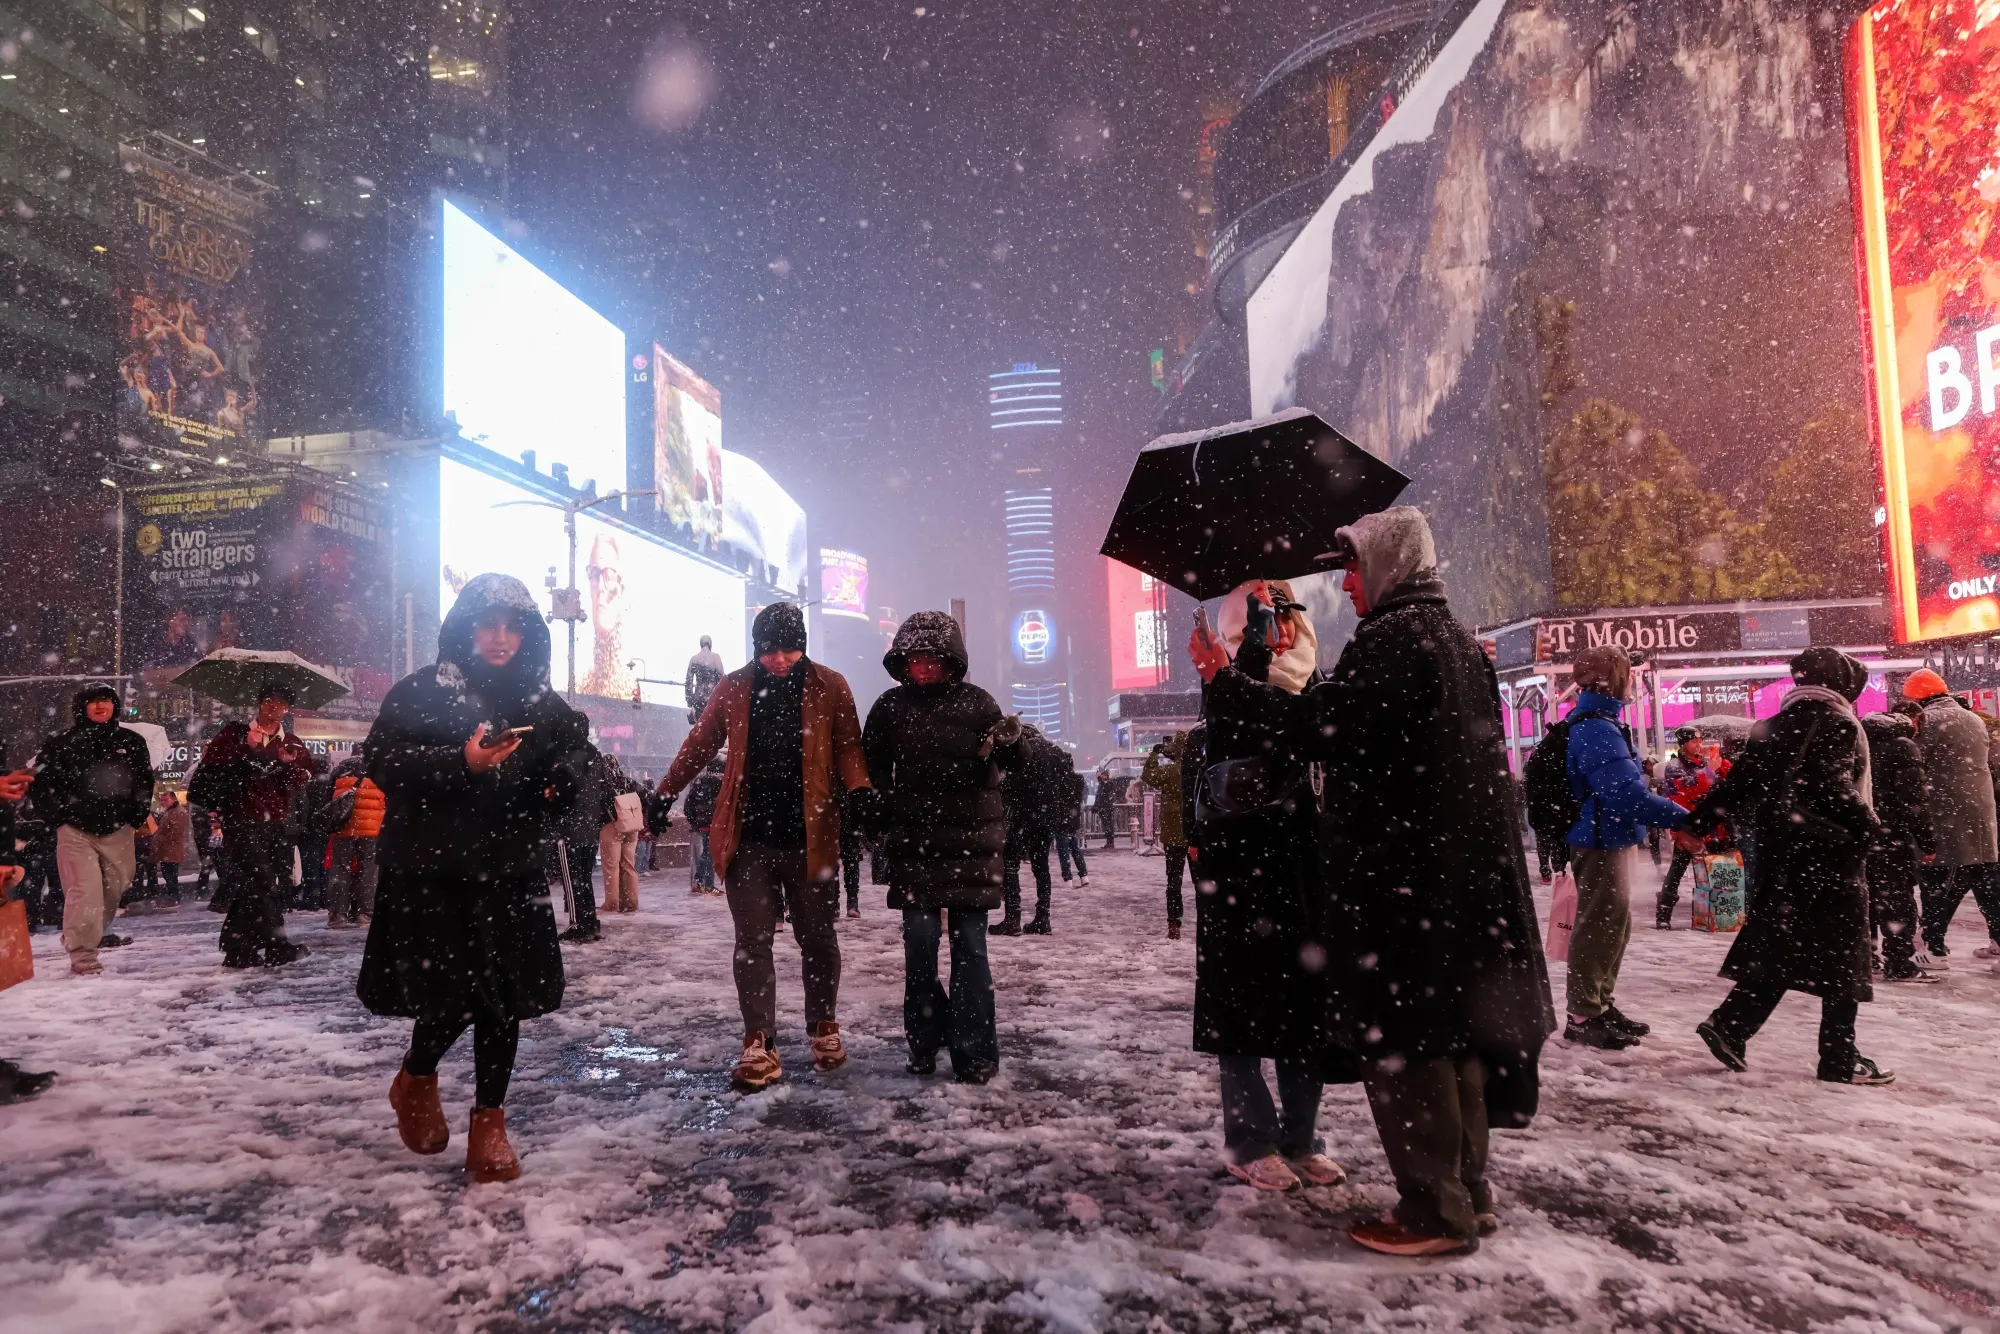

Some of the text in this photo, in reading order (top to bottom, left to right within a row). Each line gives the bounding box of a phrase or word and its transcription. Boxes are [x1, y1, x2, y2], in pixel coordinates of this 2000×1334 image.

[1397, 31, 1437, 91] MARRIOTT
[180, 219, 251, 268] GREAT
[148, 233, 240, 284] GATSBY
[633, 372, 648, 382] LG
[169, 415, 206, 430] BROADWAY
[207, 425, 236, 438] THEATRE
[187, 426, 224, 440] BROADWAY
[301, 503, 339, 530] WORLD
[341, 516, 375, 541] COULD
[170, 529, 207, 550] two
[162, 544, 256, 571] strangers
[210, 576, 229, 585] new
[1948, 575, 1997, 600] ONLY
[1584, 618, 1699, 651] Mobile
